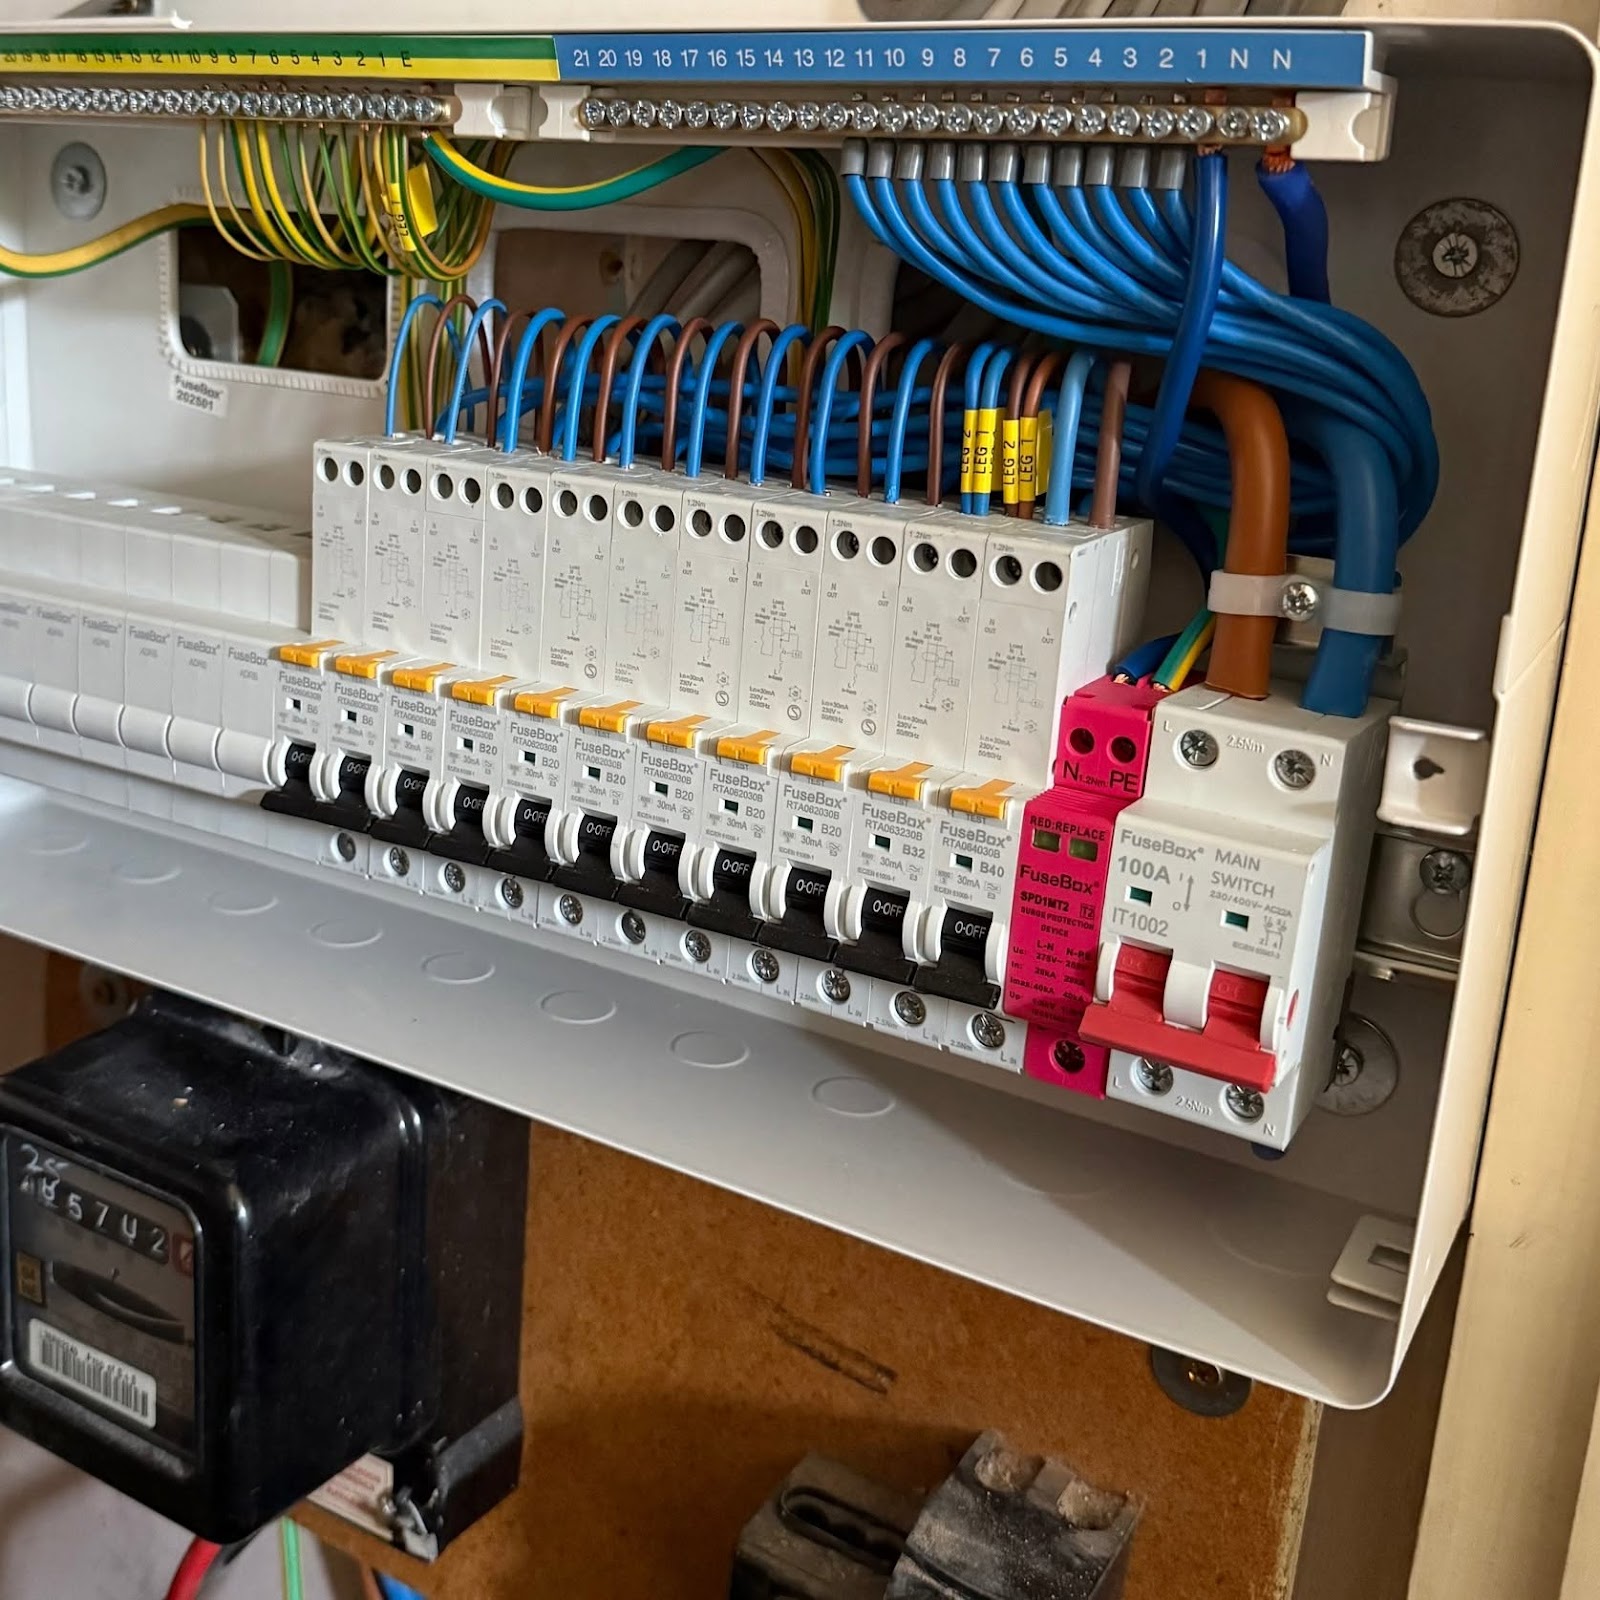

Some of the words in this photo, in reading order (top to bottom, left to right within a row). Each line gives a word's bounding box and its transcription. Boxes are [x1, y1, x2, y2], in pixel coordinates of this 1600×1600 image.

[152, 49, 162, 63] 12
[171, 50, 181, 63] 11
[189, 50, 201, 64] 10
[209, 49, 219, 63] 9
[229, 49, 237, 63] 8
[249, 49, 256, 64] 7
[270, 49, 279, 64] 6
[291, 50, 299, 65] 5
[312, 51, 319, 65] 4
[334, 50, 342, 65] 3
[357, 51, 365, 66] 2
[380, 52, 385, 67] 1
[401, 52, 412, 67] E
[574, 50, 589, 66] 21
[599, 50, 616, 66] 20
[625, 50, 642, 66] 19
[654, 50, 671, 66] 18
[681, 50, 698, 66] 17
[708, 50, 726, 66] 16
[737, 49, 755, 66] 15
[765, 50, 783, 66] 14
[795, 49, 814, 66] 13
[825, 49, 844, 67] 12
[856, 50, 872, 66] 11
[885, 49, 904, 66] 10
[922, 49, 933, 66] 9
[954, 48, 966, 67] 8
[989, 48, 1000, 66] 7
[1021, 48, 1033, 67] 6
[1055, 48, 1067, 67] 5
[1089, 49, 1102, 66] 4
[1124, 48, 1137, 67] 3
[1160, 48, 1173, 68] 2
[1198, 49, 1206, 68] 1
[1231, 49, 1247, 68] N
[1274, 50, 1290, 69] N
[176, 375, 220, 399] FuseBox
[963, 430, 970, 438] 2
[1004, 441, 1015, 449] 2
[961, 448, 970, 473] LEG
[974, 447, 987, 474] LEG
[1021, 455, 1033, 482] LEG
[1004, 458, 1015, 485] LEG
[228, 647, 267, 666] FuseBox
[278, 670, 323, 692] FuseBox
[335, 682, 380, 703] FuseBox
[307, 704, 318, 714] B6
[391, 696, 438, 717] FuseBox
[362, 716, 373, 726] B6
[450, 710, 496, 731] FuseBox
[421, 730, 432, 740] B6
[511, 722, 559, 743] FuseBox
[479, 743, 497, 755] B20
[575, 738, 625, 760] FuseBox
[1227, 735, 1265, 754] 2.5Nm
[1320, 754, 1332, 766] N
[542, 757, 559, 769] B20
[641, 752, 693, 775] FuseBox
[525, 768, 543, 779] 30mA
[606, 772, 626, 785] B20
[710, 769, 765, 792] FuseBox
[1063, 761, 1079, 780] N
[1110, 770, 1138, 793] PE
[588, 785, 606, 797] 30mA
[675, 789, 693, 801] B20
[784, 785, 842, 810] FuseBox
[657, 800, 676, 812] 30mA
[745, 806, 765, 819] B20
[786, 801, 840, 820] RTA062030B
[727, 818, 747, 830] 30mA
[862, 803, 926, 830] FuseBox
[966, 814, 986, 825] TEST
[821, 824, 841, 837] B20
[865, 819, 922, 841] RTA063230B
[940, 821, 1005, 848] FuseBox
[801, 836, 822, 848] 30mA
[902, 844, 926, 859] B32
[942, 837, 1000, 859] RTA064030B
[1120, 829, 1197, 861] FuseBox
[1215, 848, 1260, 871] MAIN
[880, 856, 903, 871] 30mA
[980, 862, 1004, 877] B40
[957, 874, 980, 889] 30mA
[1020, 865, 1093, 895] FuseBox
[1118, 856, 1170, 884] 100A
[1211, 870, 1275, 898] SWITCH
[1020, 891, 1069, 912] SPD1MT2
[1082, 906, 1093, 918] T2
[1041, 924, 1068, 937] DEVICE
[1112, 908, 1168, 937] IT1002
[922, 1029, 928, 1039] L
[1001, 1051, 1007, 1061] L
[1113, 1077, 1121, 1088] L
[1264, 1124, 1275, 1136] N
